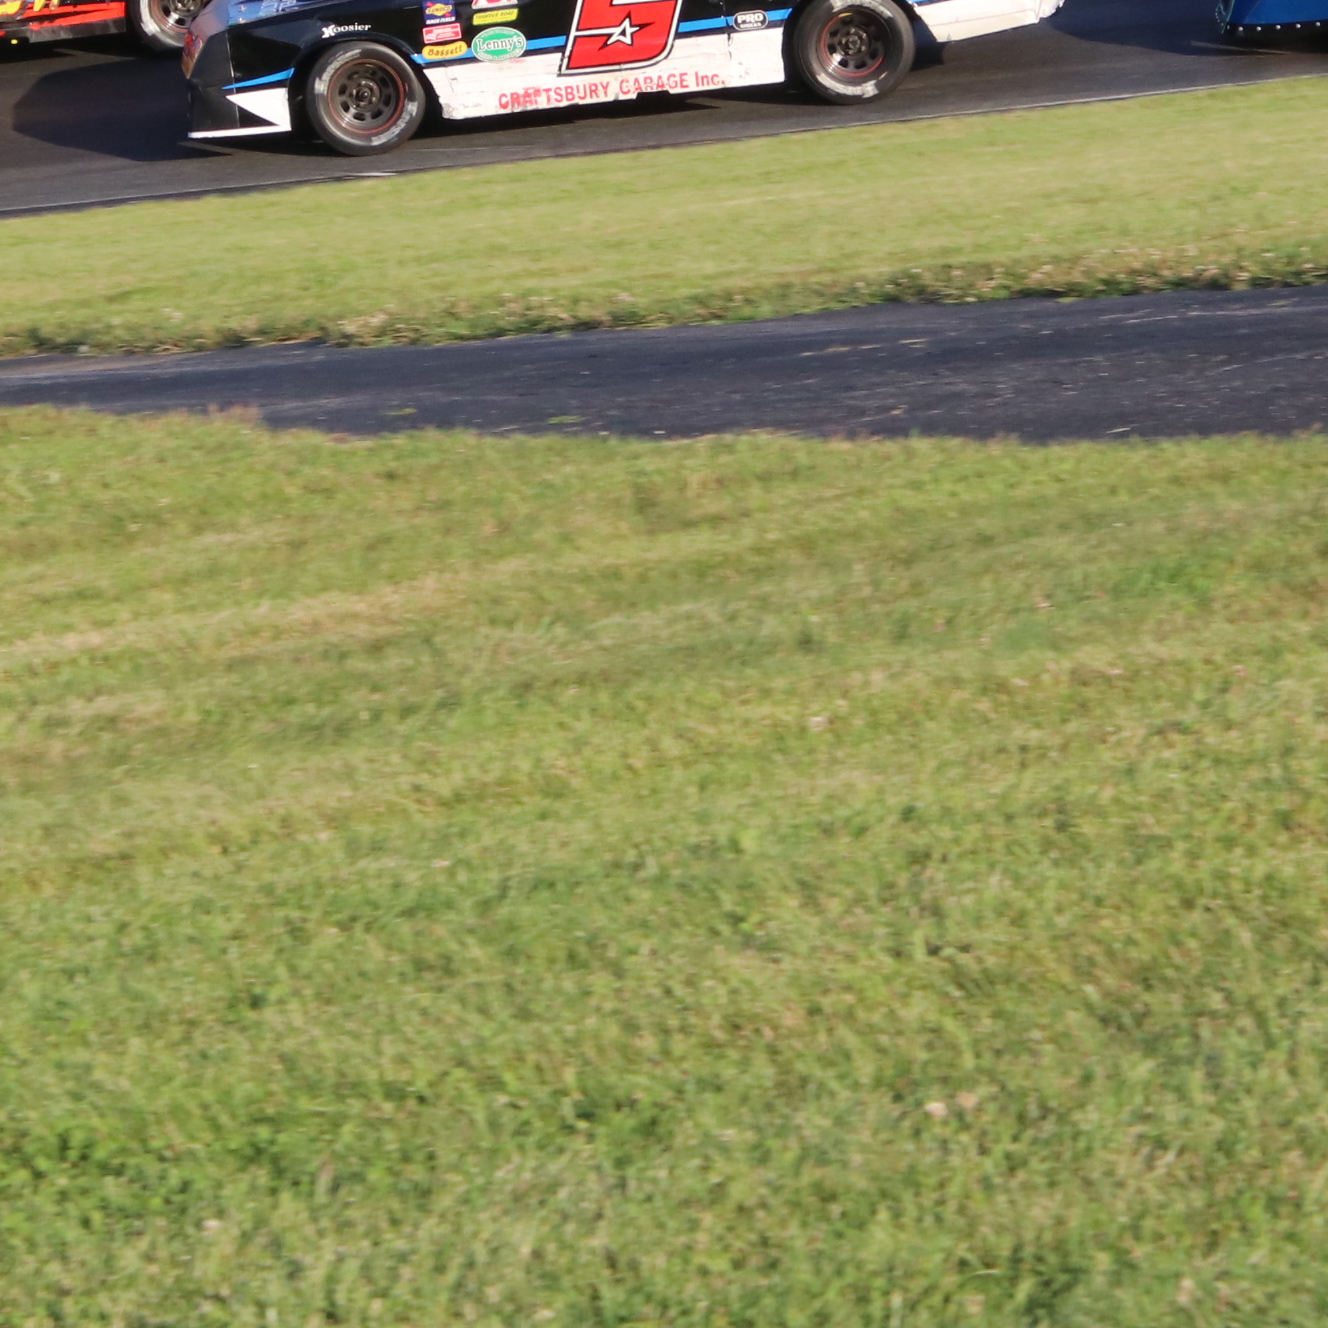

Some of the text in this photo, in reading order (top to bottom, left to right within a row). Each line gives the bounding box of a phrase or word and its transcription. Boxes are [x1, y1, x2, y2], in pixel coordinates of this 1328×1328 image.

[737, 13, 764, 24] PRO
[321, 23, 372, 39] Hoosier
[427, 44, 463, 56] Bassett
[477, 36, 524, 52] Lenny's
[498, 81, 610, 110] CRAFTSBURY
[619, 72, 690, 95] GARAGE
